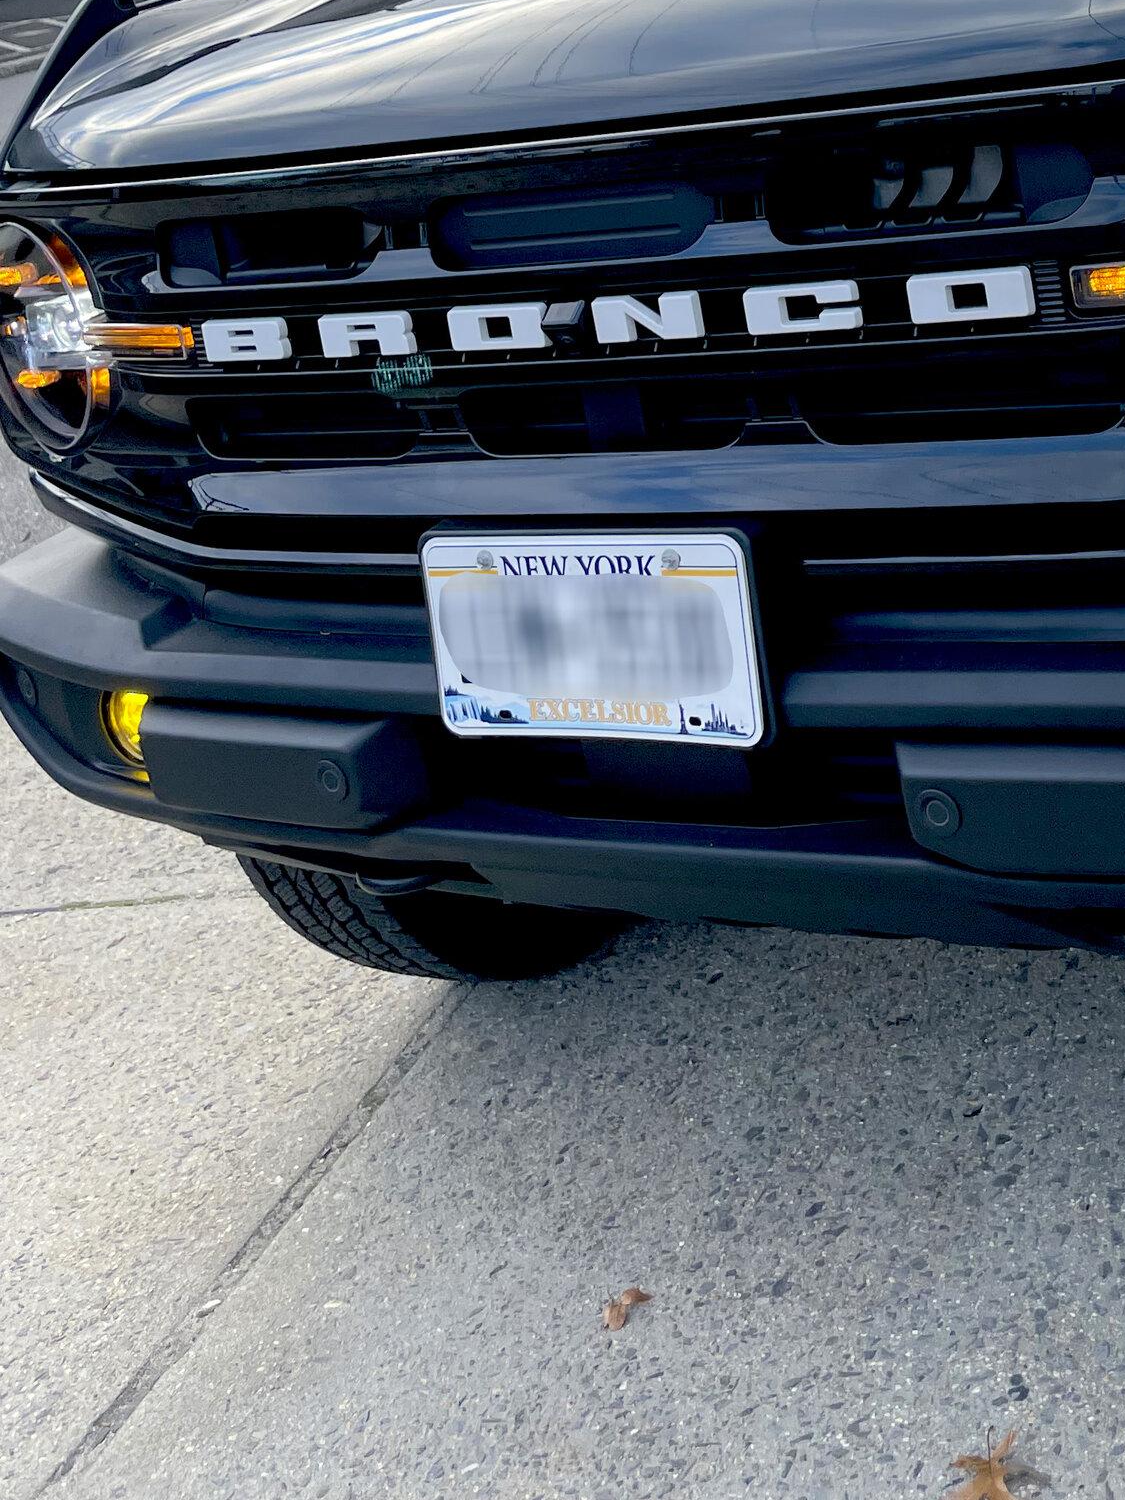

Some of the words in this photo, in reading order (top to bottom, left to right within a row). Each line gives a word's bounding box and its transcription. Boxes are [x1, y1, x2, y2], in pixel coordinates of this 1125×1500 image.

[201, 265, 1035, 363] BRONCO
[500, 555, 567, 577] NEW
[575, 554, 656, 577] YORK
[526, 698, 672, 727] EXCELSIOR
